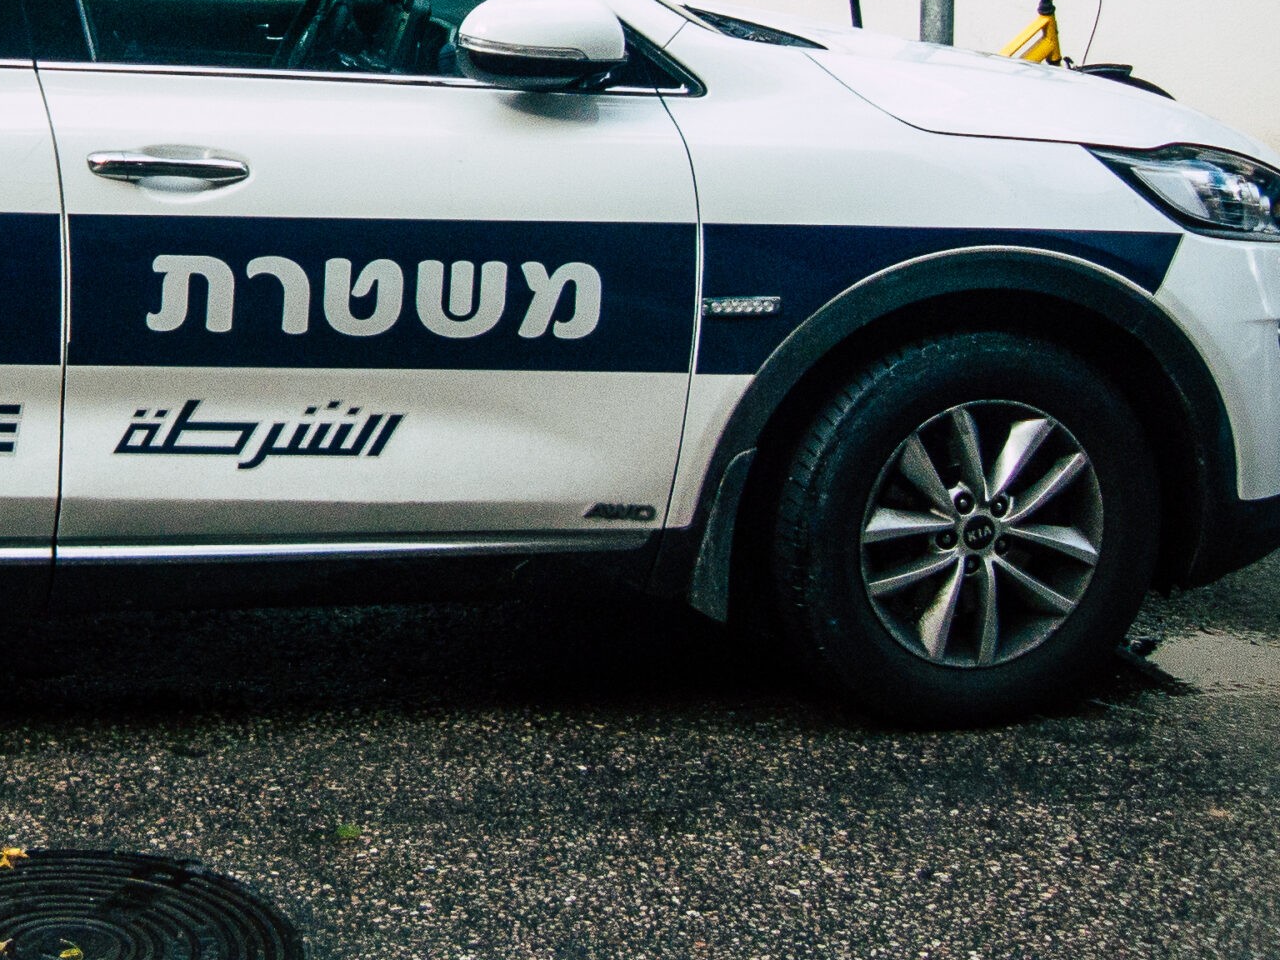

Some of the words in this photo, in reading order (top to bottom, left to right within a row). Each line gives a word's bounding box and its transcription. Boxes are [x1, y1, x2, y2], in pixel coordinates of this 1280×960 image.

[146, 254, 602, 339] משטרת
[113, 399, 405, 470] الشرطة
[582, 502, 657, 522] AWD
[966, 525, 993, 542] KIA
